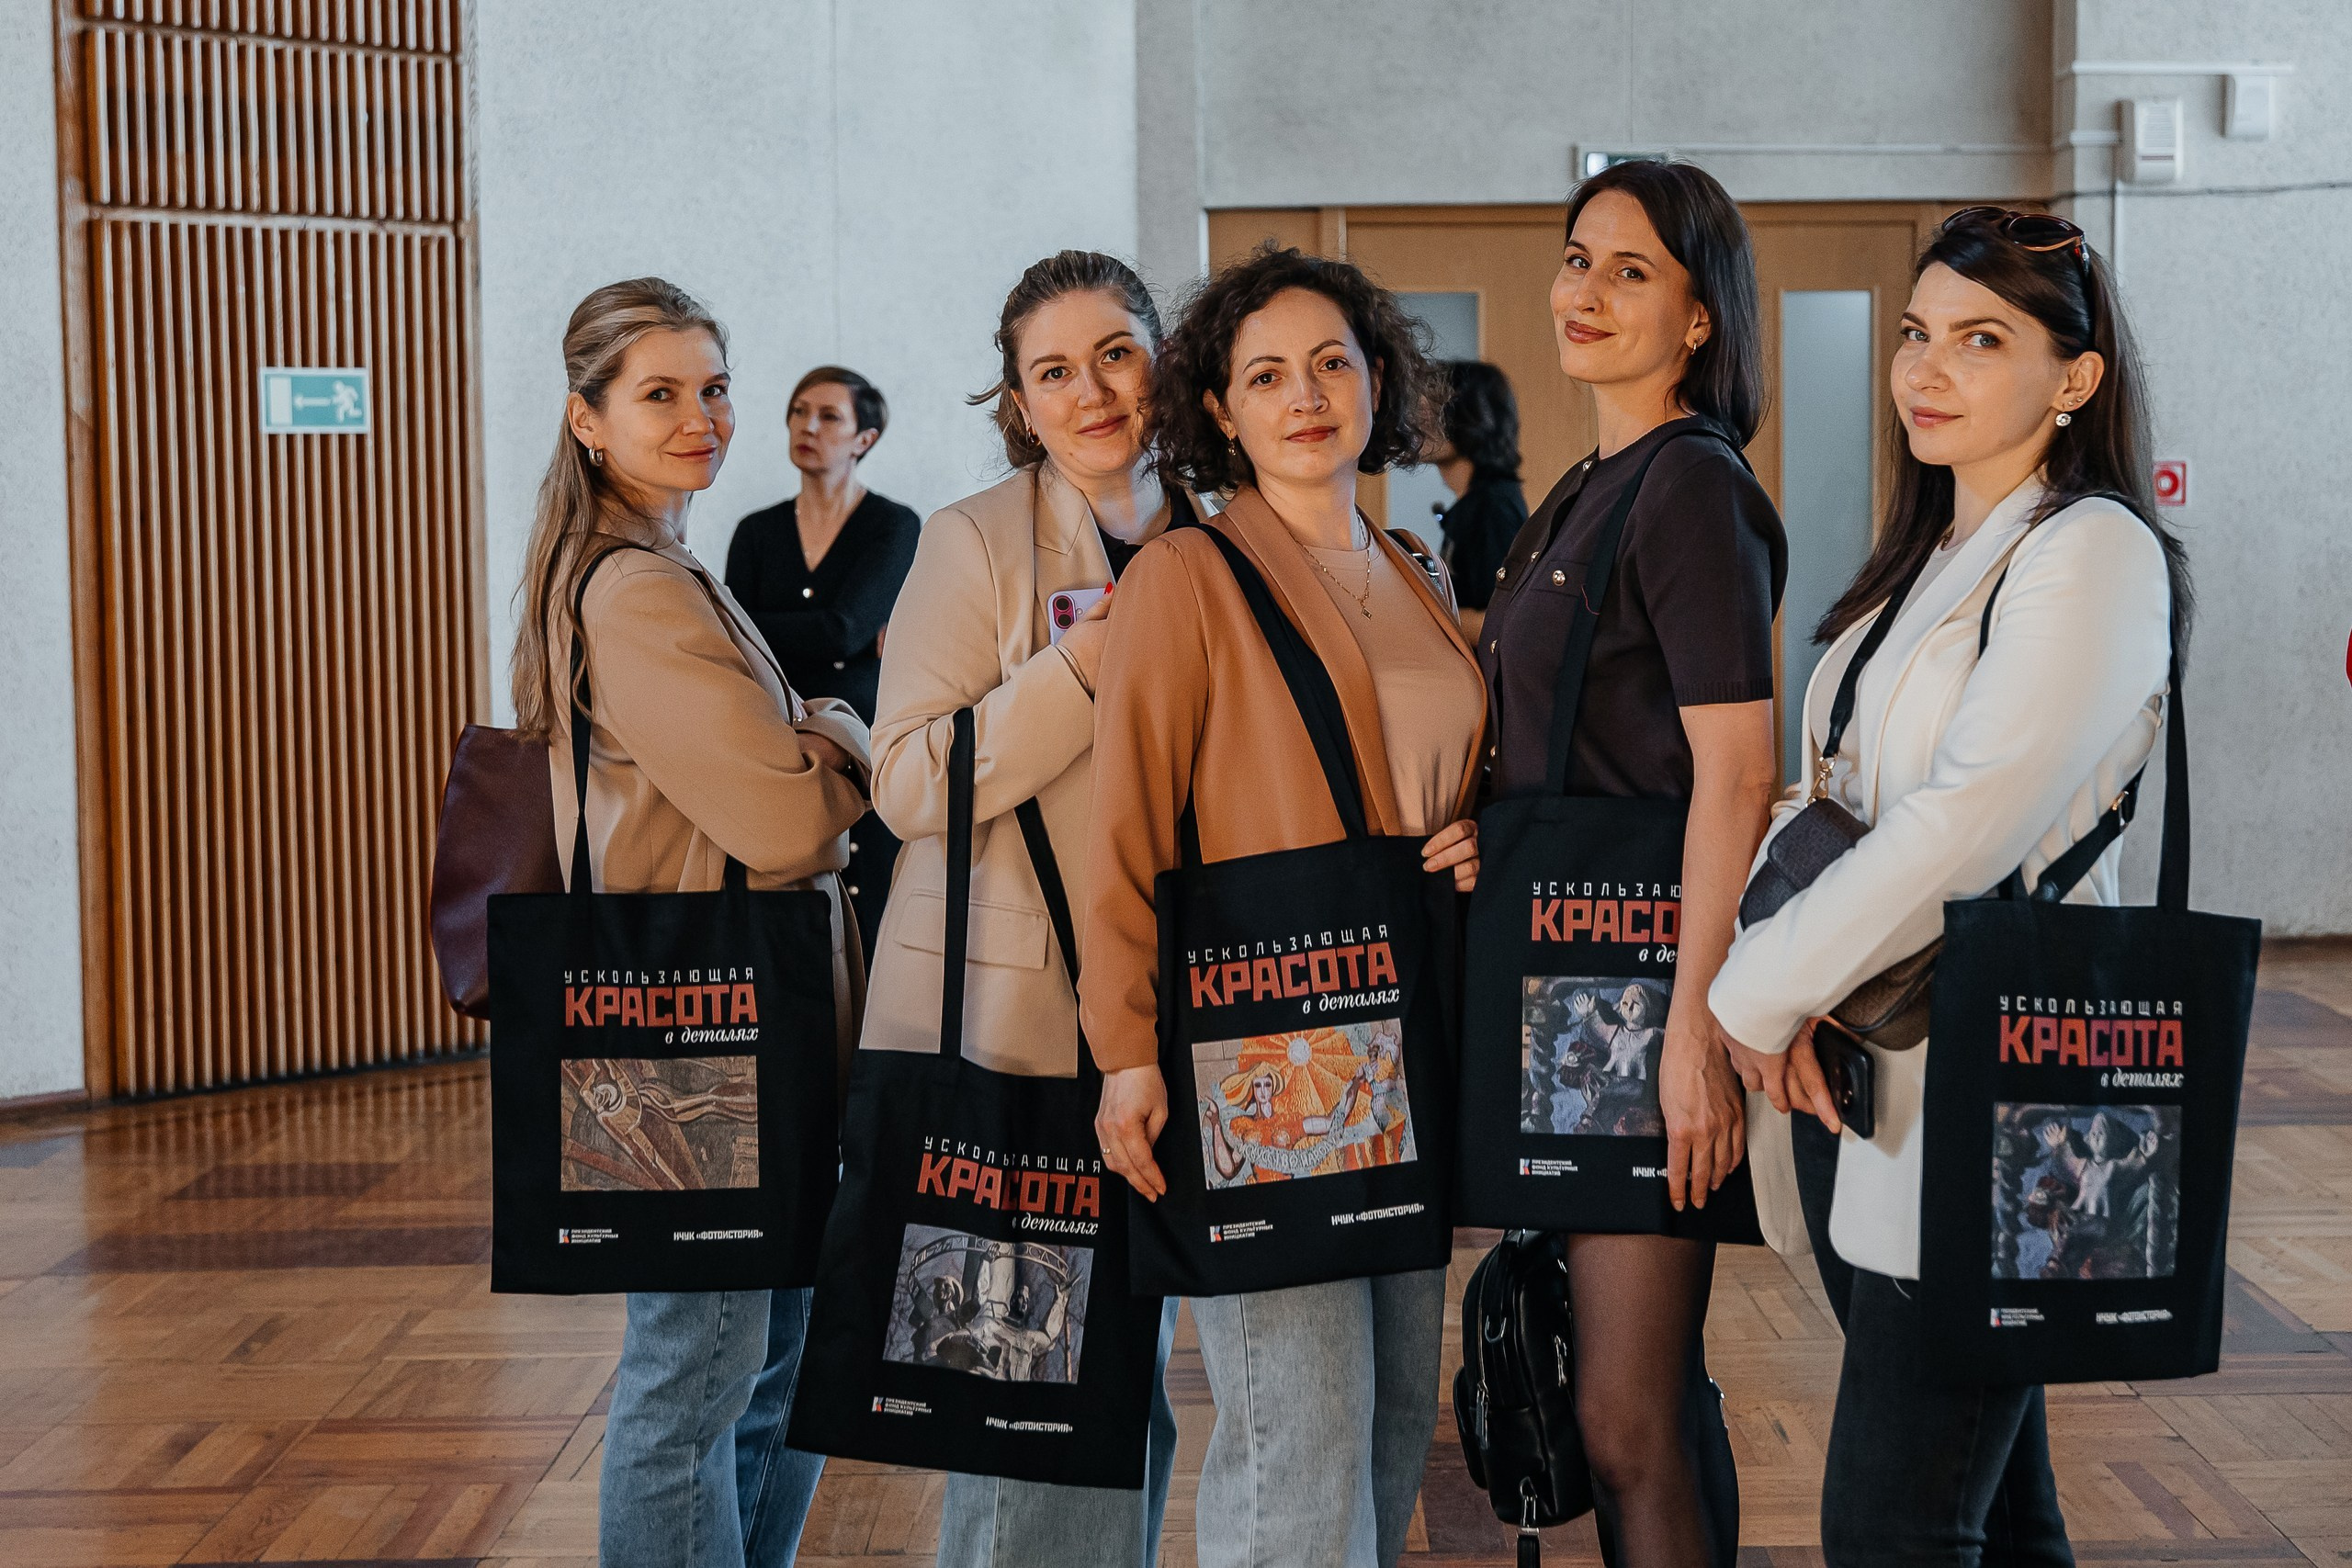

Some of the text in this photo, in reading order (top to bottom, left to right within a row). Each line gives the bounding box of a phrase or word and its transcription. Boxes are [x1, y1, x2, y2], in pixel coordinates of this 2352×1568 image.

[1532, 881, 1682, 898] УСКОЛЬЗАЮ
[1532, 898, 1682, 943] КРАСО
[1187, 924, 1388, 964] УСКОЛЬЗАЮЩАЯ
[564, 966, 753, 985] УСКОЛЬЗАЮЩАЯ
[1190, 942, 1398, 1008] КРАСОТА
[565, 983, 758, 1028] КРАСОТА
[1302, 987, 1400, 1014] в деталях
[1999, 995, 2183, 1017] УСКОЛЬЗАЮЩАЯ
[664, 1025, 759, 1044] в деталях
[1999, 1015, 2184, 1066] КРАСОТА
[917, 1152, 1100, 1217] КРАСОТА
[1021, 1212, 1099, 1235] деталях
[1331, 1202, 1425, 1226] НЧУК «ФОТОИСТОРИЯ»
[673, 1229, 763, 1241] НЧУК «ФОТОИСТОРИЯ»
[1009, 1421, 1073, 1433] «ФОТОИСТОРИЯ»
